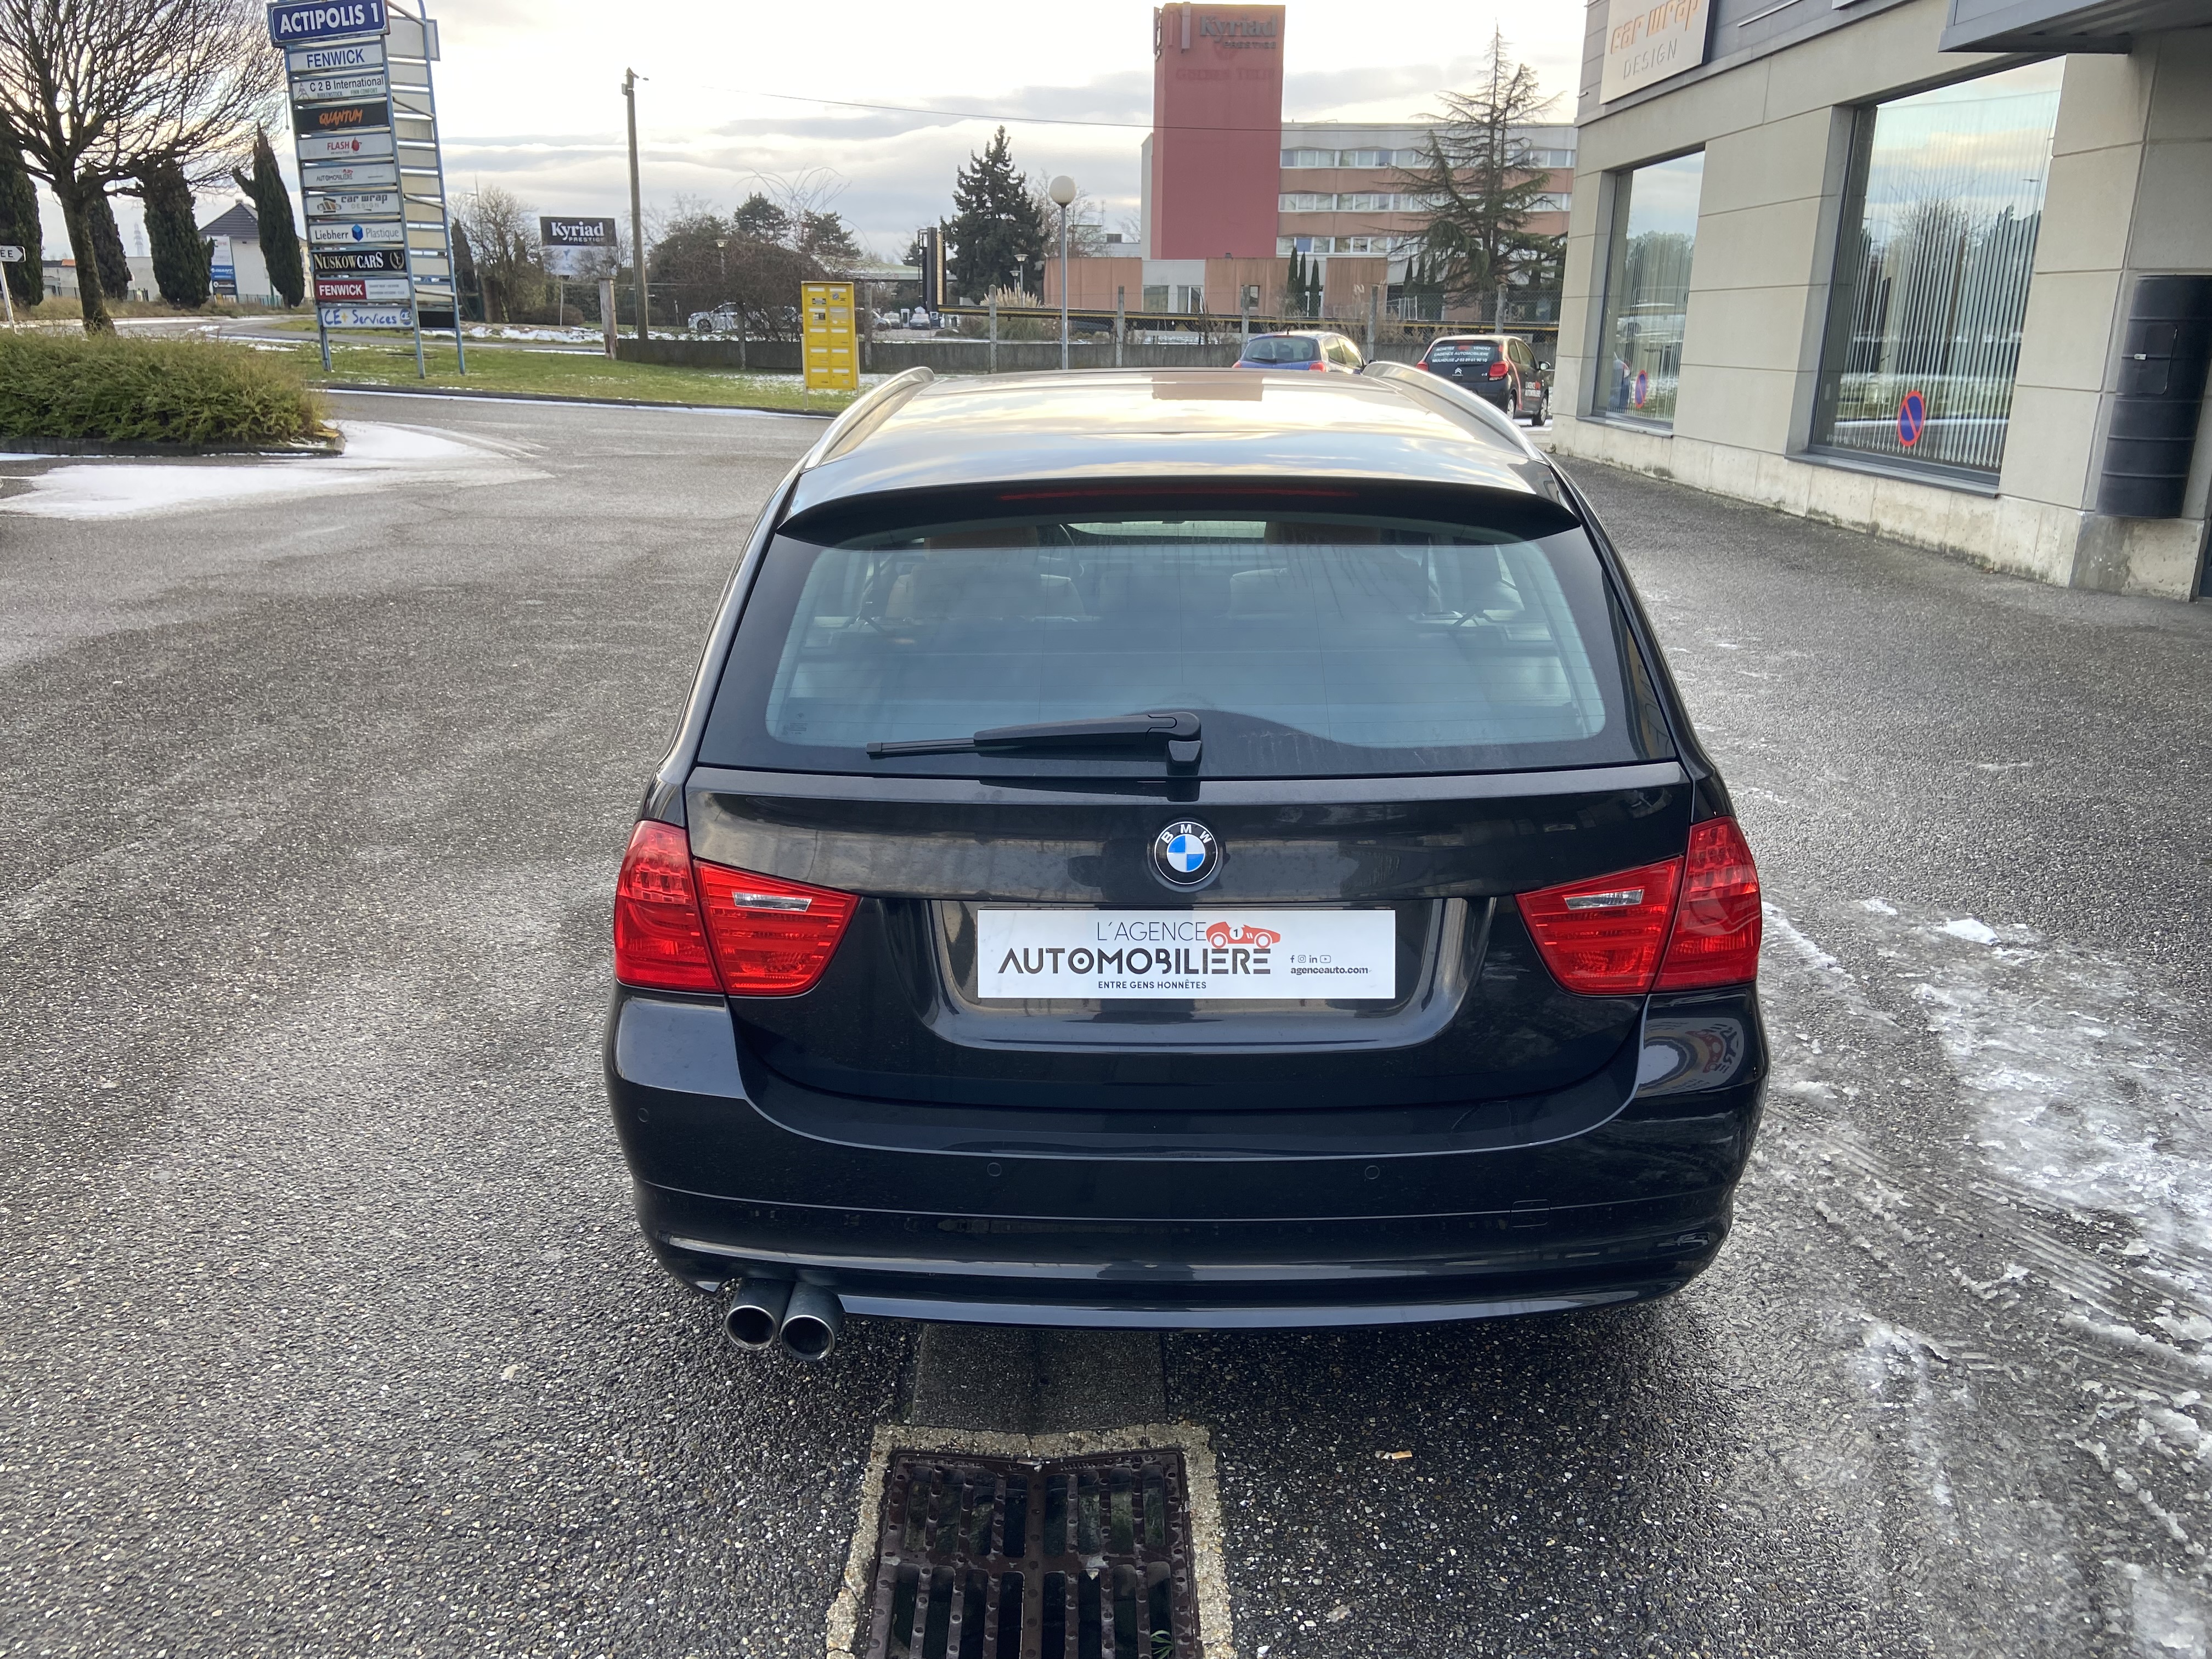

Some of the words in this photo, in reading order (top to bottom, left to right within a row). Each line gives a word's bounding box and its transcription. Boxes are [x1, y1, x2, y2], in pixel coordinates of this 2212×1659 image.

[280, 4, 365, 34] ACTIPOLIS
[370, 2, 379, 23] 1
[1199, 14, 1277, 43] Kyriad
[1610, 14, 1645, 55] car
[1646, 0, 1701, 37] wrap
[307, 48, 365, 68] FENWICK
[1623, 38, 1677, 80] DESIGN
[309, 82, 316, 92] C
[318, 82, 323, 91] 2
[325, 81, 331, 91] B
[334, 75, 384, 90] International
[319, 109, 363, 126] QUANTUM
[327, 141, 350, 150] FLASH
[361, 194, 388, 204] wrap
[315, 229, 349, 240] Liebherr
[365, 227, 399, 241] Plastique
[551, 221, 605, 240] Kyriad
[319, 284, 363, 296] FENWICK
[352, 309, 397, 325] Services
[1160, 823, 1212, 844] BMW
[1097, 922, 1207, 941] L'AGENCE
[1290, 966, 1368, 975] agenceauto.com
[1158, 979, 1207, 989] HONNÊTES
